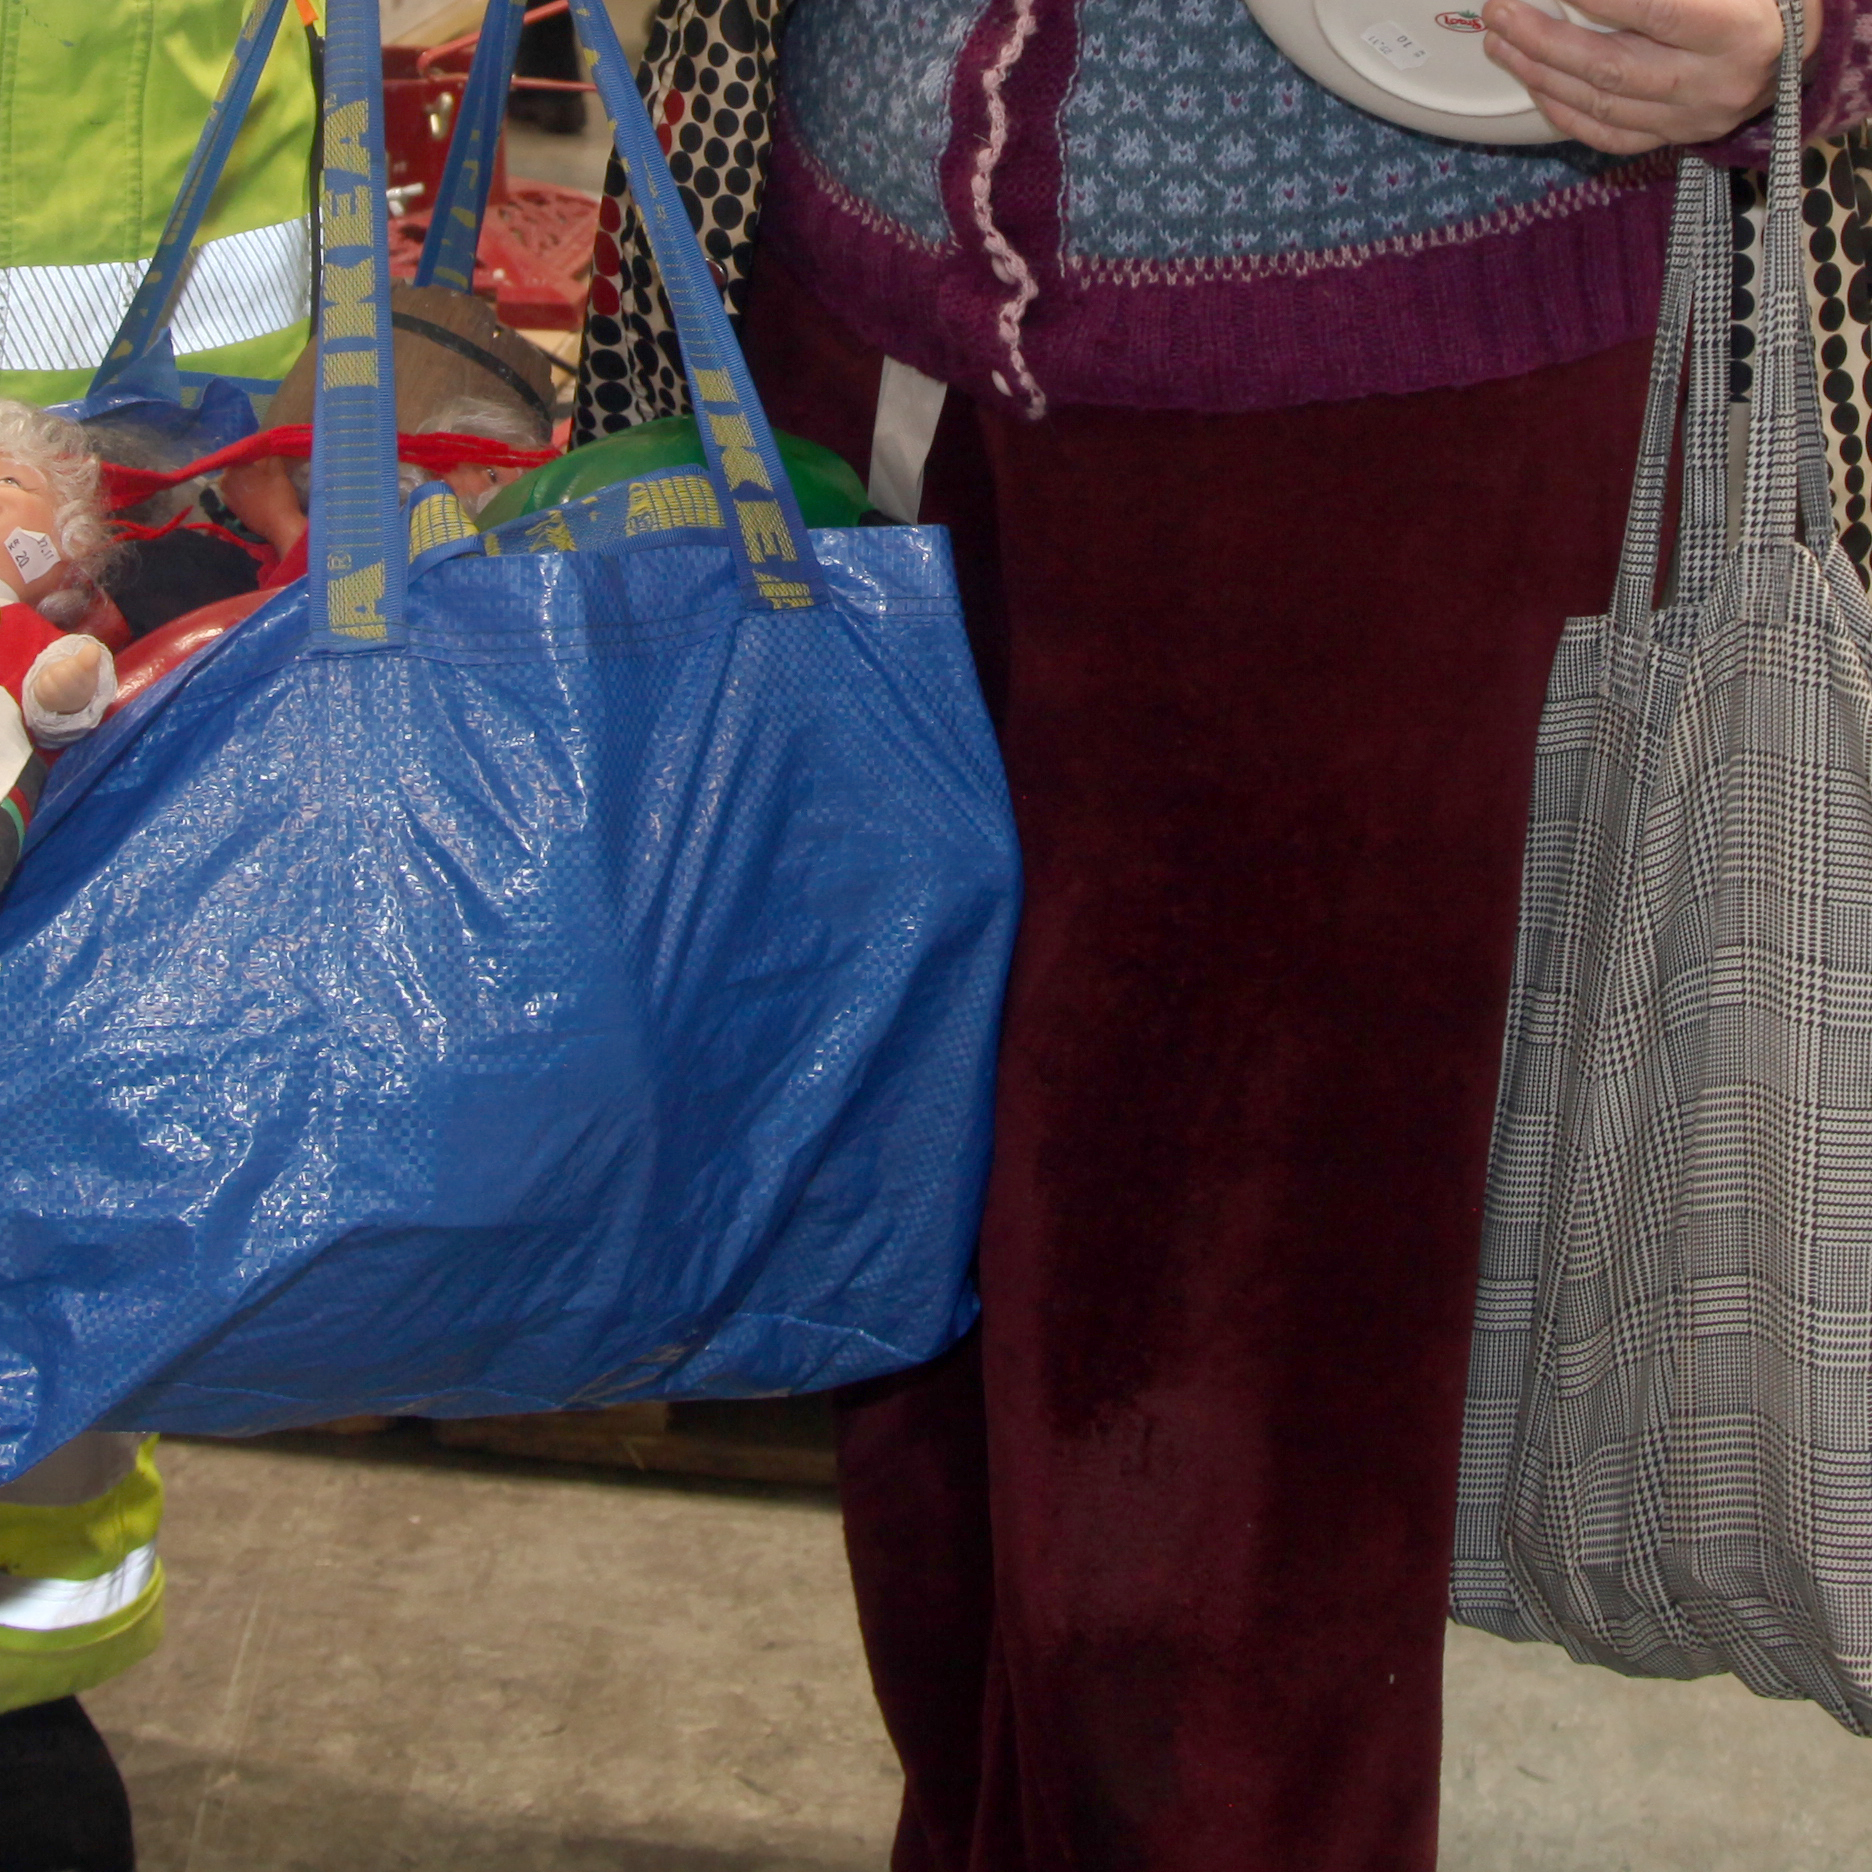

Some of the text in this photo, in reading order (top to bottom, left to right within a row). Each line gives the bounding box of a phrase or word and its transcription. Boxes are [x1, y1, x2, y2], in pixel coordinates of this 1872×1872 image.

[322, 98, 379, 389] IKEA
[7, 538, 21, 551] KR
[14, 550, 31, 569] 20
